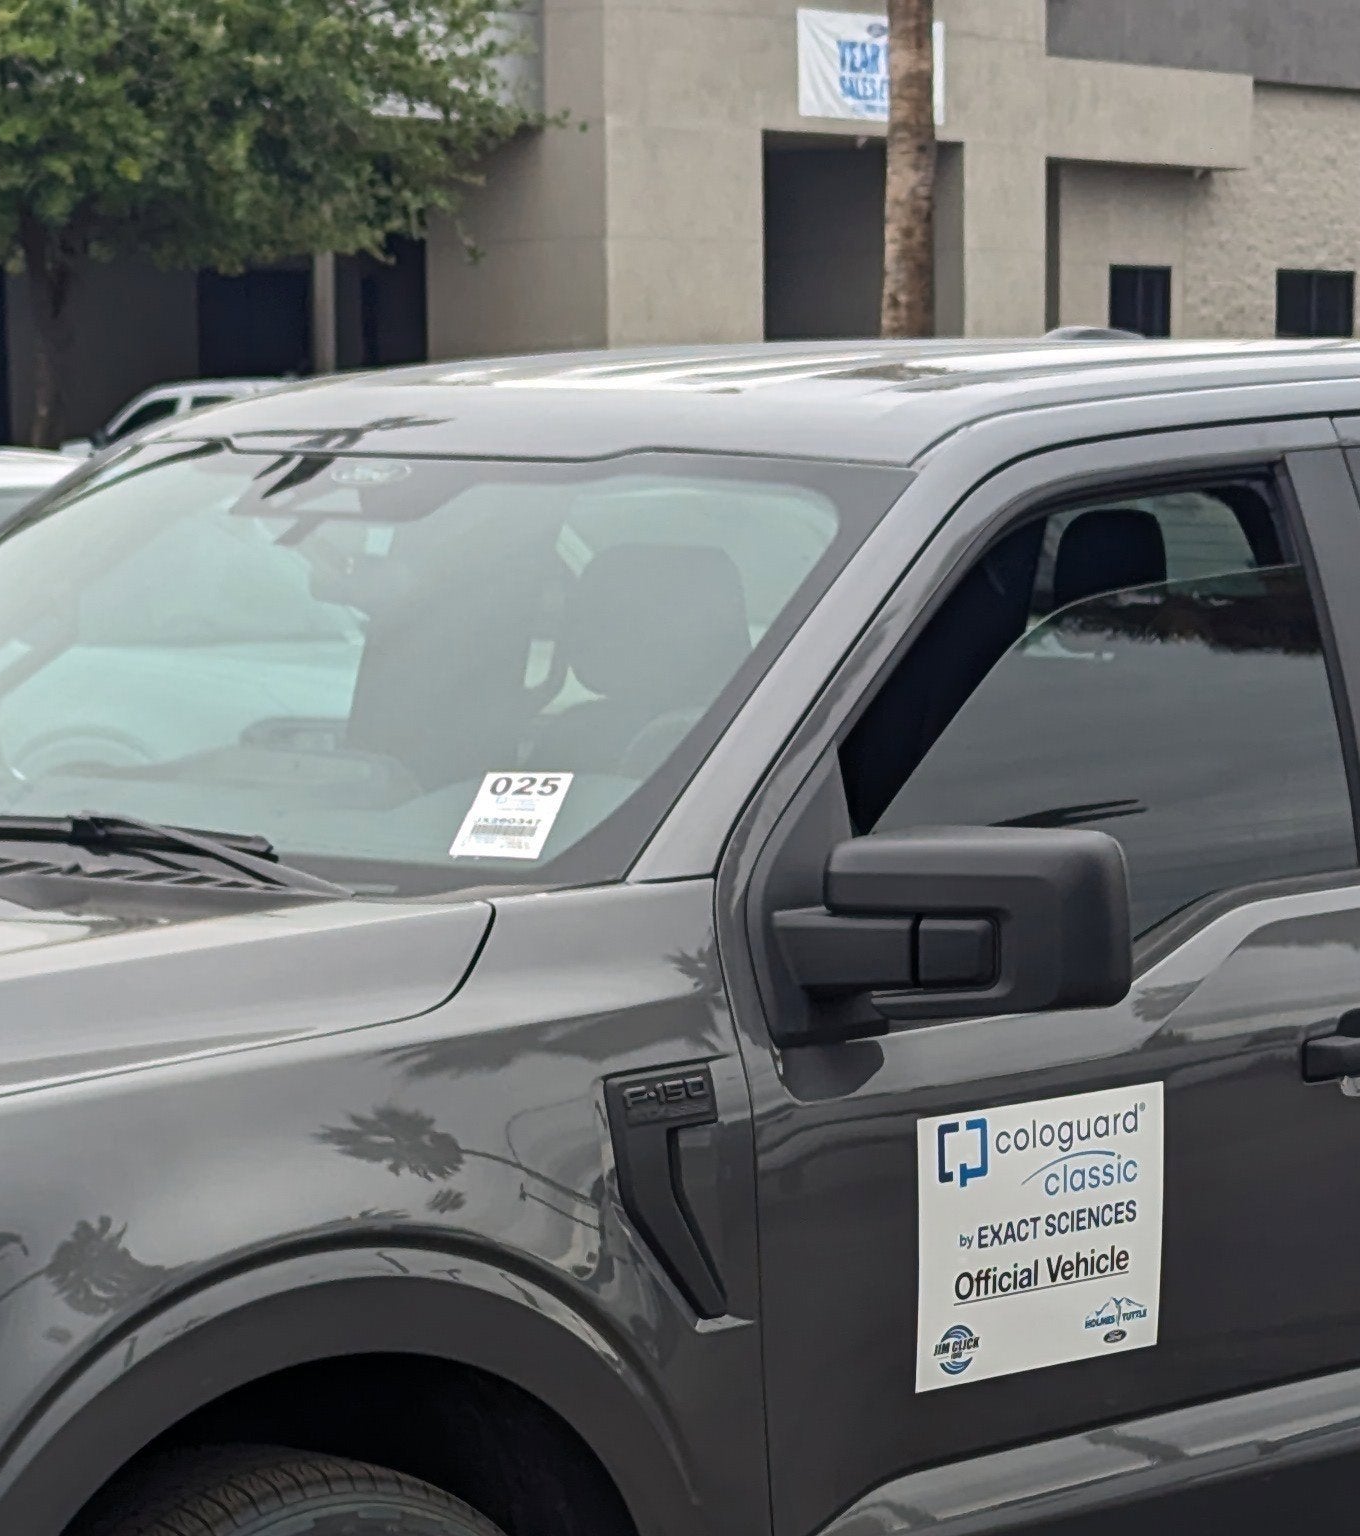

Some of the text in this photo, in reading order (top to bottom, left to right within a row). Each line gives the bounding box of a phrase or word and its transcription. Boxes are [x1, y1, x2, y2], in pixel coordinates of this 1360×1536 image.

[490, 777, 561, 796] 025
[1044, 1154, 1138, 1196] classic
[959, 1199, 1137, 1250] by EXACT SCIENCES
[954, 1245, 1130, 1301] Official Vehicle
